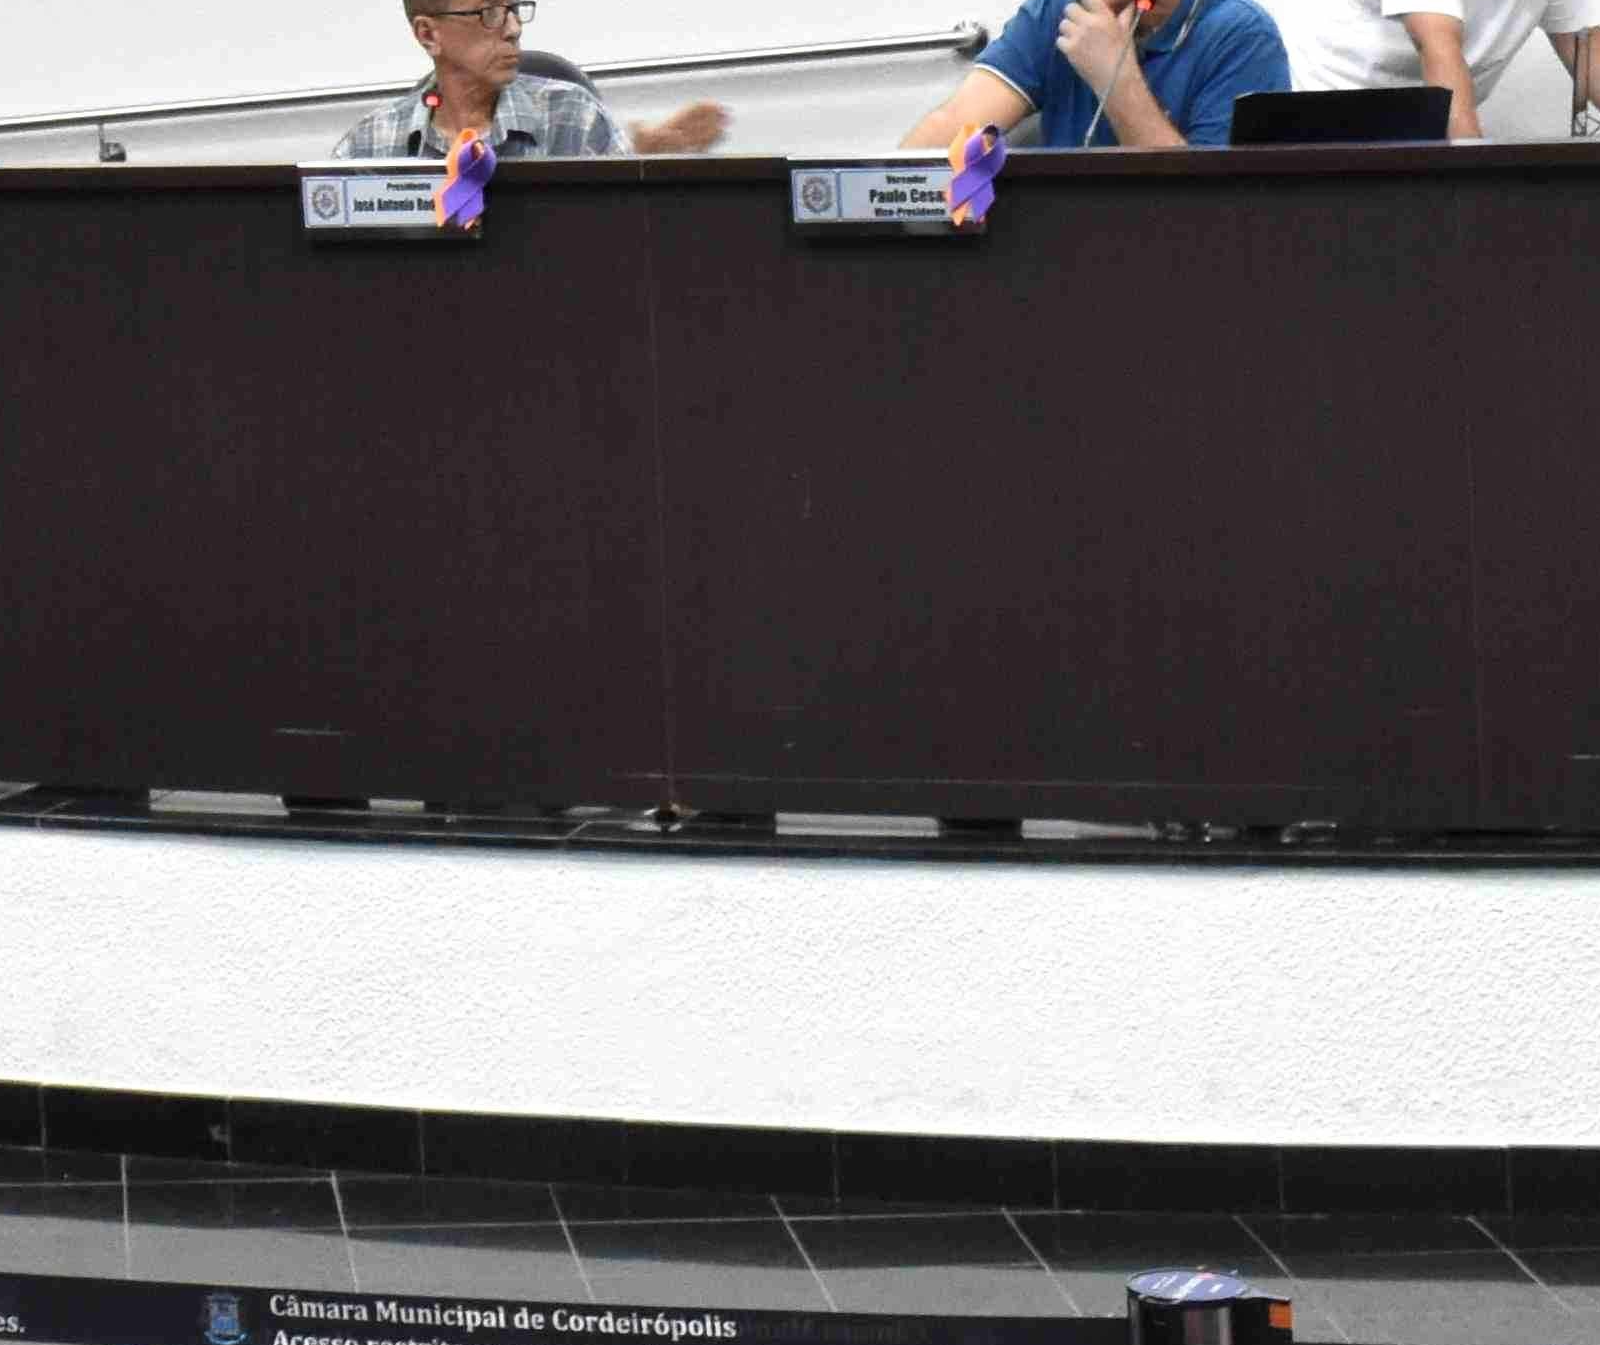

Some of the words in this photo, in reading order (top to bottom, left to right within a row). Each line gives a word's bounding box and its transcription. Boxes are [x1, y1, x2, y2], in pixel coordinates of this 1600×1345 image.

[869, 189, 907, 204] Paulo
[910, 189, 944, 203] Cesa
[270, 1295, 368, 1320] Câmara
[376, 1301, 506, 1330] Municipal
[514, 1307, 544, 1329] de
[552, 1310, 736, 1340] Cordeirópolis
